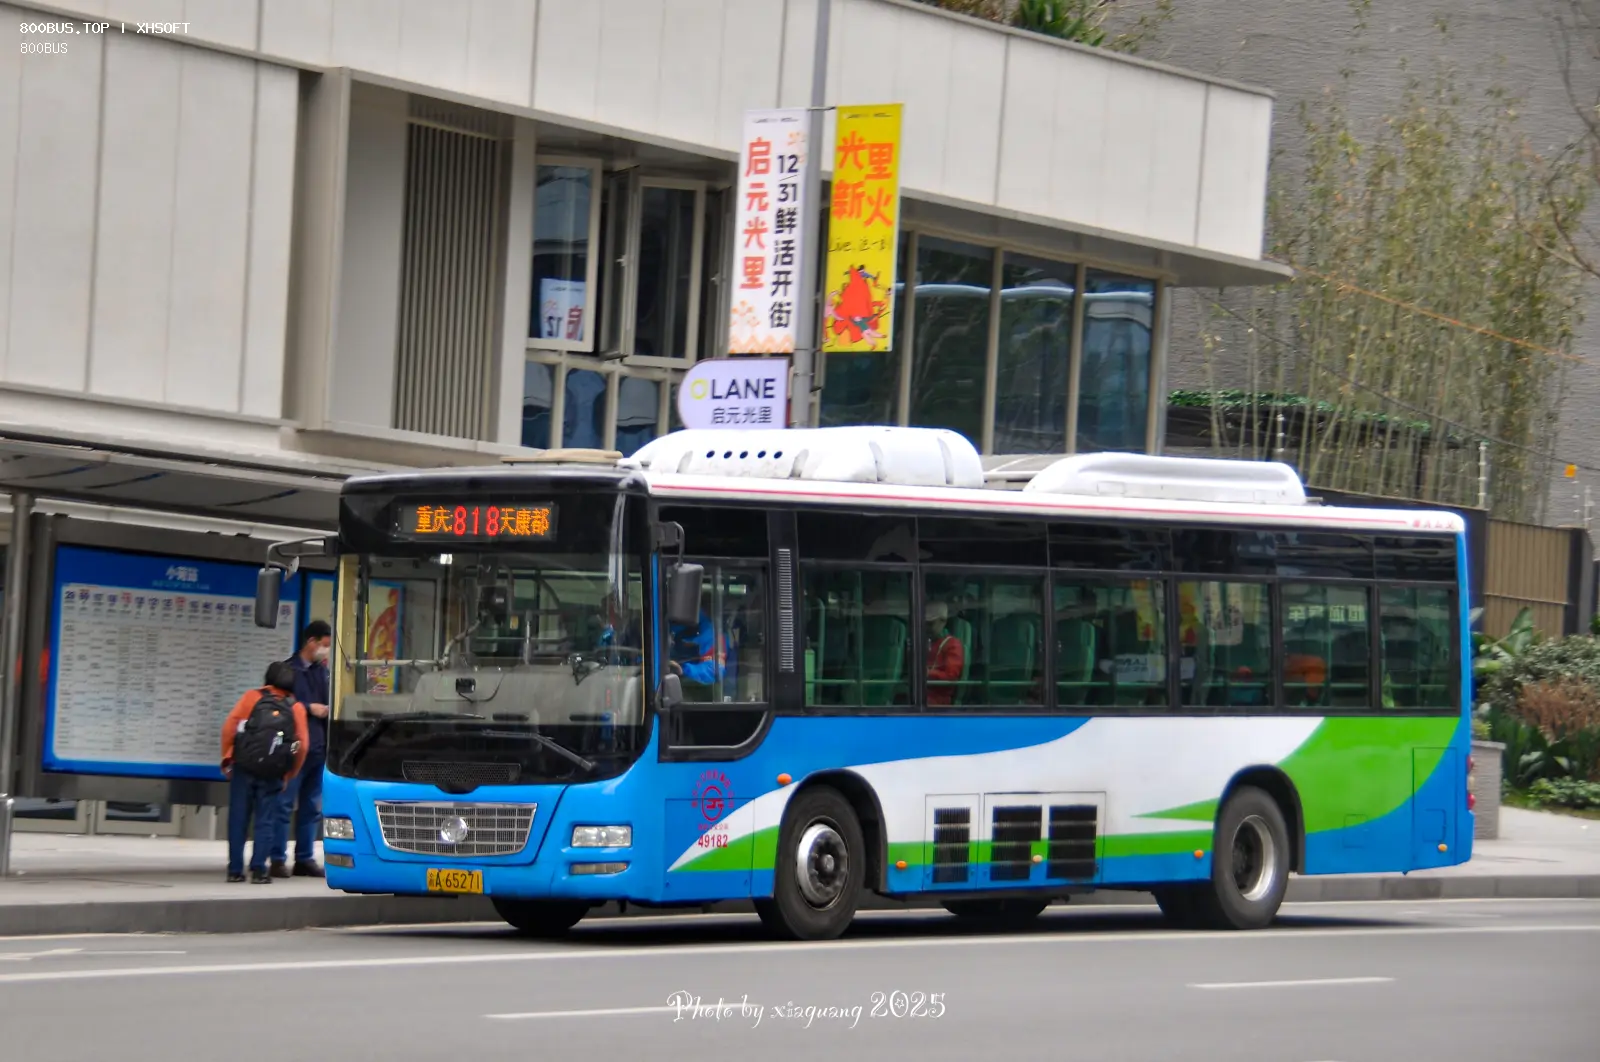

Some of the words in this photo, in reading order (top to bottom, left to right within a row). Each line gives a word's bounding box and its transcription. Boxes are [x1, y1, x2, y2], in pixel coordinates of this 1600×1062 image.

[836, 130, 895, 180] 光里
[739, 136, 772, 290] 启元光里
[832, 179, 893, 228] 新火
[711, 406, 772, 424] 启元光里
[453, 505, 500, 536] 818
[698, 834, 729, 849] 49182
